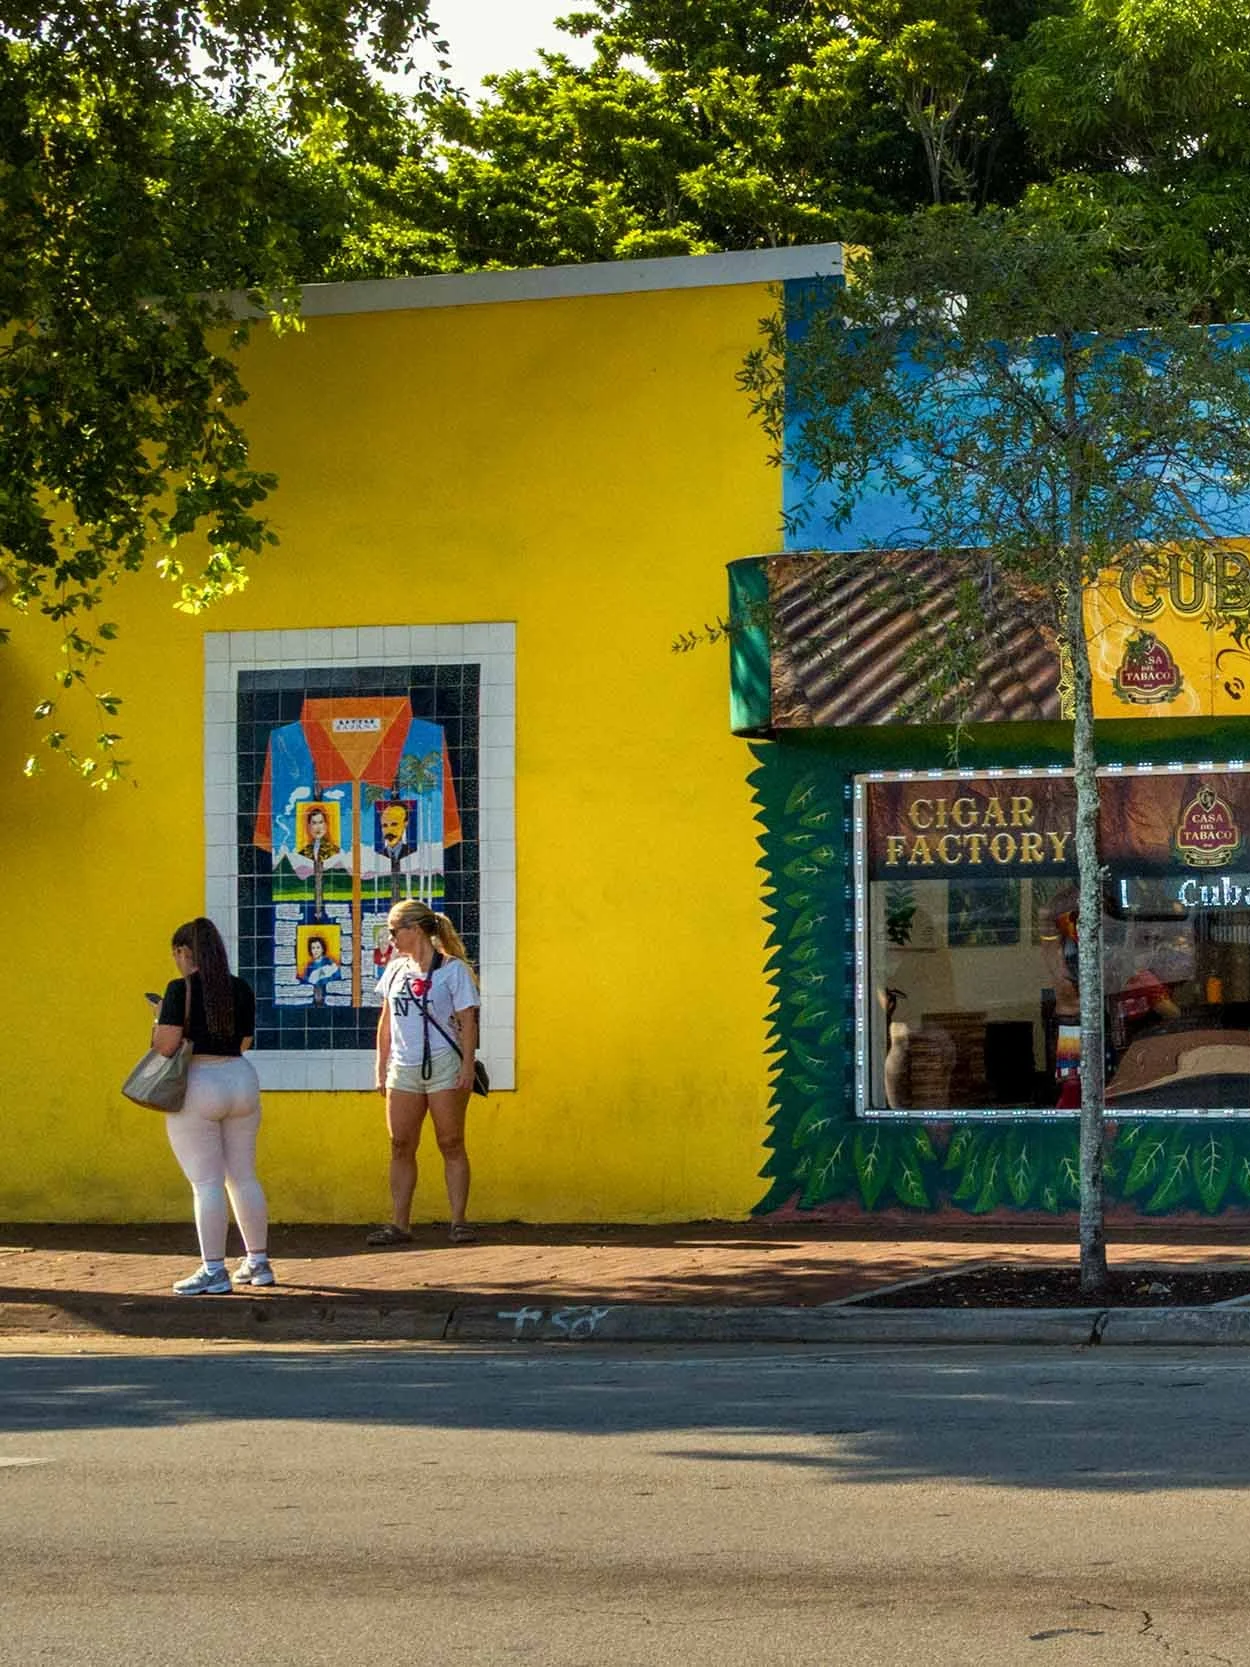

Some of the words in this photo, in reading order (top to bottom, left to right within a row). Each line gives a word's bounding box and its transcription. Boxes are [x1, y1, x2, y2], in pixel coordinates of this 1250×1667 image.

[1126, 672, 1170, 681] TABACO
[908, 796, 1034, 829] CIGAR
[1192, 813, 1224, 824] CASA
[1183, 830, 1233, 841] TABACO
[885, 831, 1073, 865] FACTORY
